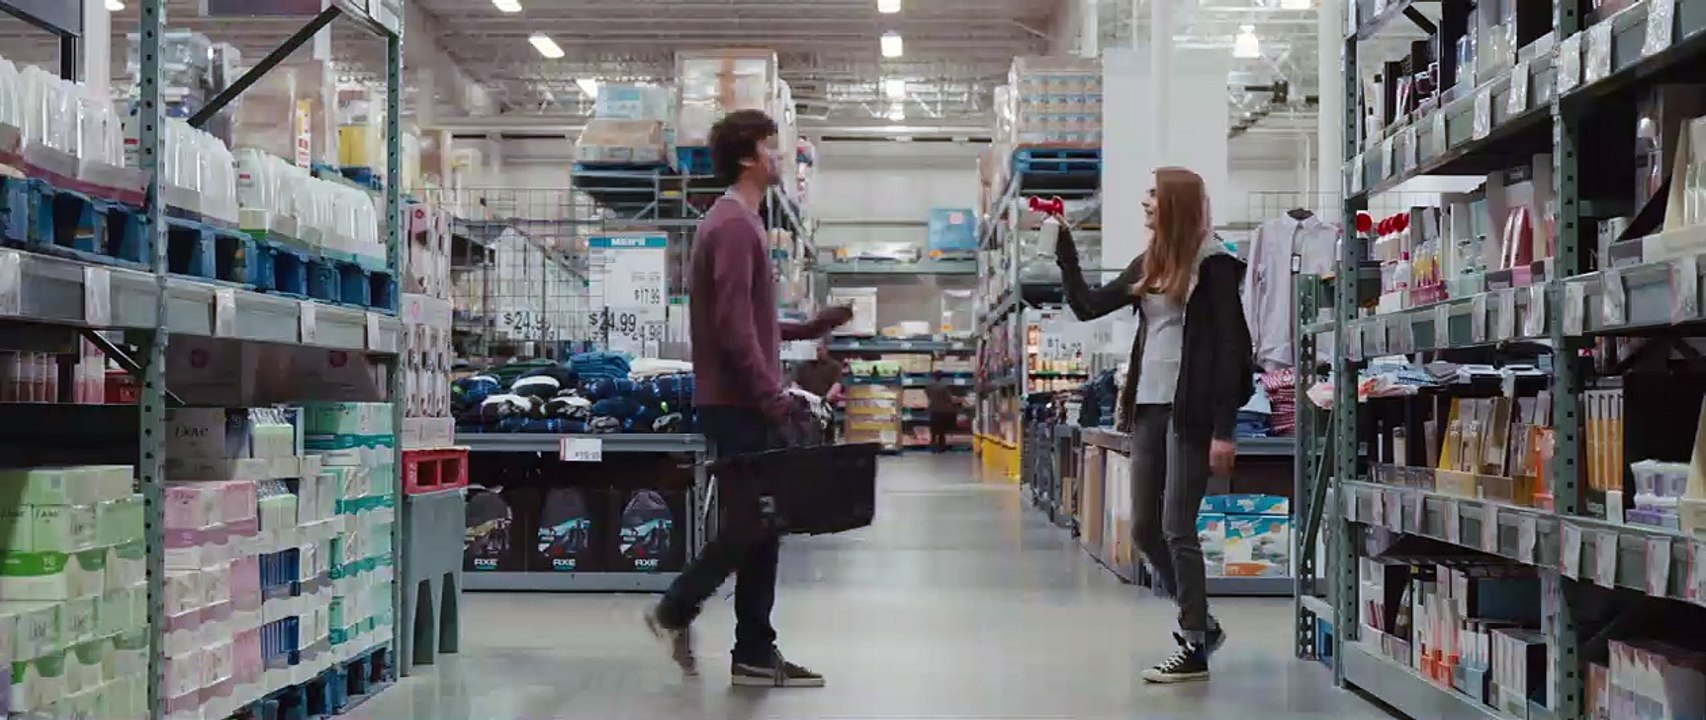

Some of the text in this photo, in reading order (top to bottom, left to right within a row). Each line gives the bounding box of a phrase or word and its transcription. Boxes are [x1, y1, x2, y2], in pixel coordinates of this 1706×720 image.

[588, 312, 637, 333] $24.99
[474, 558, 498, 566] AXE
[553, 558, 576, 566] AXE
[635, 558, 659, 566] AXE
